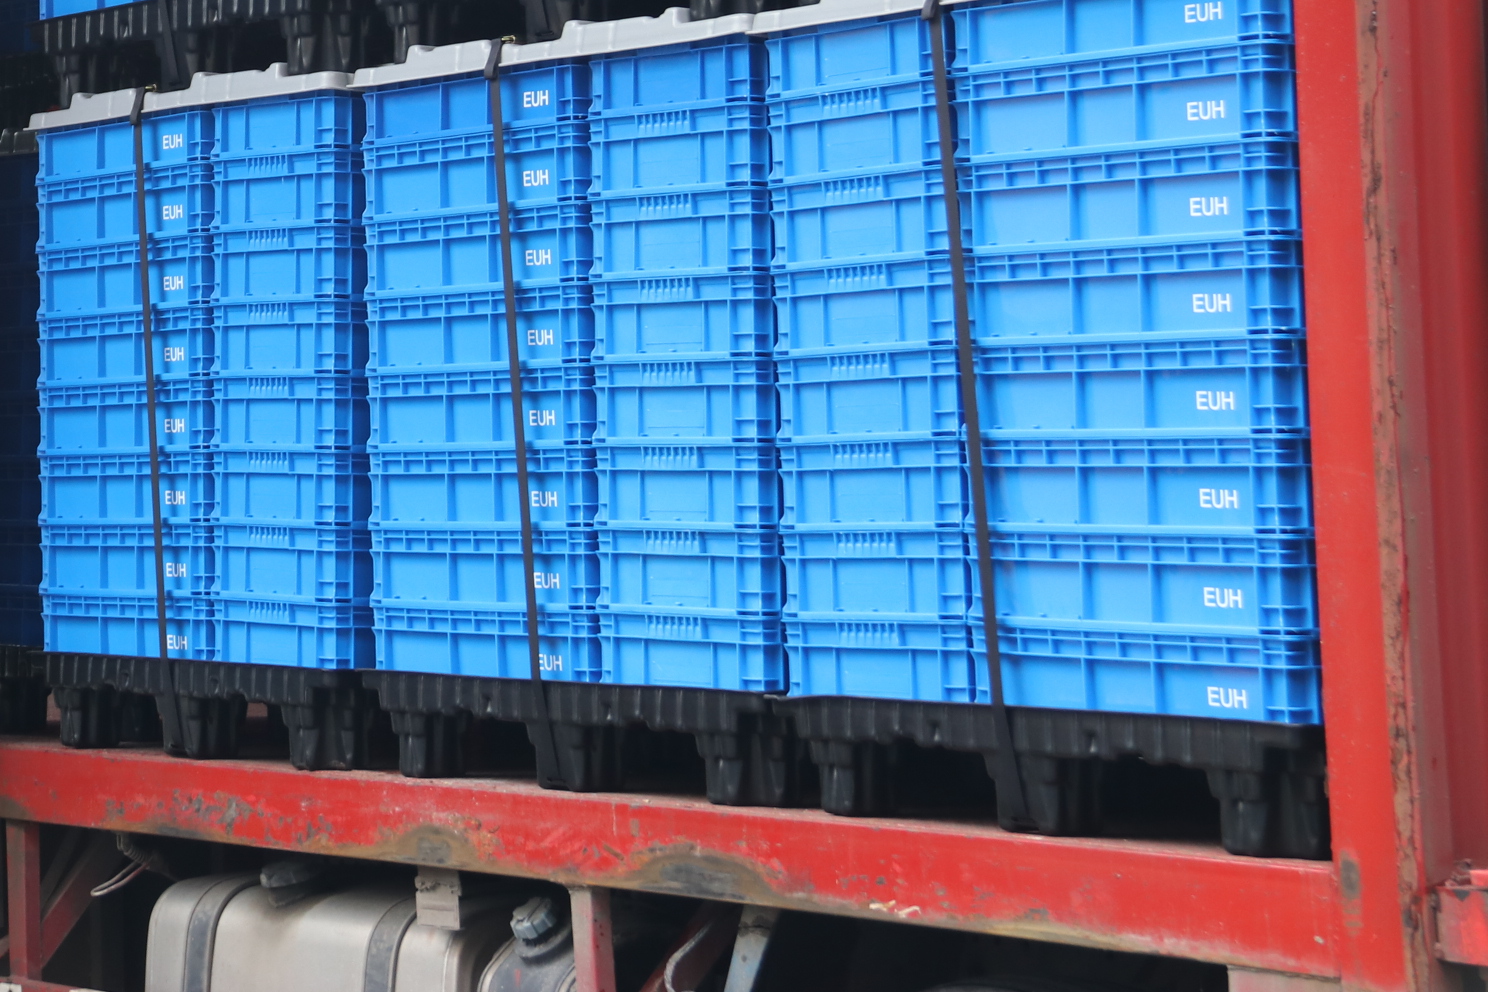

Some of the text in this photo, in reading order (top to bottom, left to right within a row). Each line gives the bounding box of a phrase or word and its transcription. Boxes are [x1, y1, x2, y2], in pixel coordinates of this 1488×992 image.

[1185, 1, 1223, 23] EUH
[524, 90, 549, 107] EUH
[1187, 100, 1225, 121] EUH
[163, 134, 183, 149] EUH
[523, 169, 549, 186] EUH
[163, 205, 183, 220] EUH
[1190, 197, 1228, 216] EUH
[526, 249, 551, 265] EUH
[164, 276, 184, 290] EUH
[1192, 294, 1231, 313] EUH
[528, 329, 554, 345] EUH
[165, 347, 184, 362] EUH
[1196, 391, 1235, 410] EUH
[165, 419, 185, 433] EUH
[529, 410, 555, 426] EUH
[165, 491, 186, 505] EUH
[531, 491, 558, 507] EUH
[1199, 488, 1239, 509] EUH
[166, 563, 186, 577] EUH
[534, 572, 560, 589] EUH
[1204, 587, 1243, 608] EUH
[167, 635, 187, 649] EUH
[538, 654, 562, 671] EUH
[1207, 686, 1248, 709] EUH
